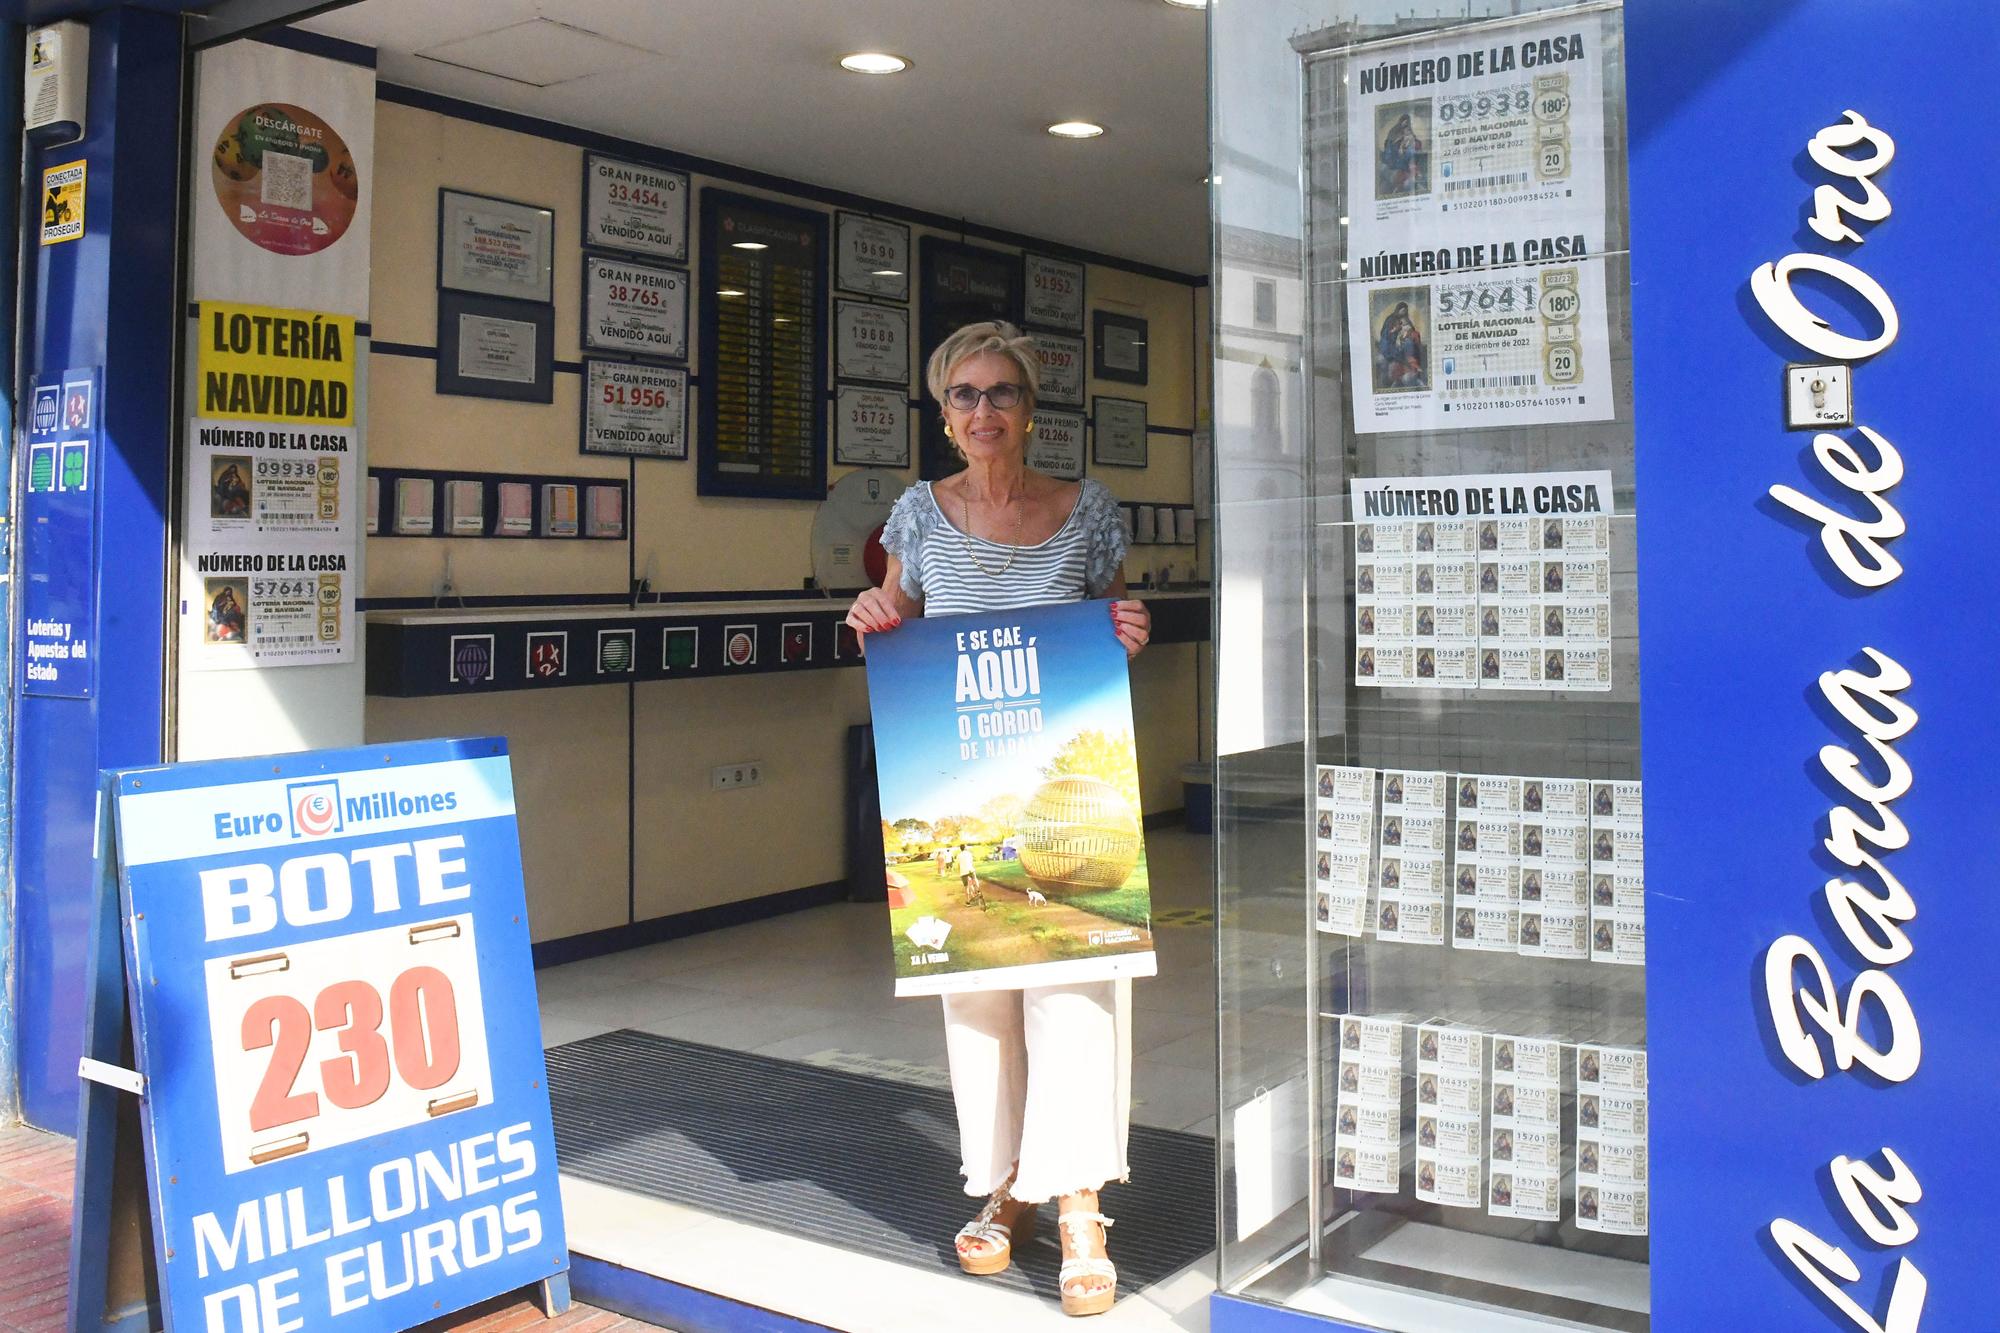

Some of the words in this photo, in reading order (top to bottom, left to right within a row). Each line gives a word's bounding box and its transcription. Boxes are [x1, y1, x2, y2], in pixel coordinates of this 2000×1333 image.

[1360, 56, 1451, 95] NÚMERO
[1457, 51, 1484, 79] DE
[1490, 46, 1516, 74] LA
[1521, 33, 1585, 68] CASA
[1439, 90, 1530, 122] 09938
[256, 115, 323, 139] DESCÁRGATE
[1480, 118, 1528, 132] NACIONAL
[1469, 131, 1512, 144] NAVIDAD
[1545, 154, 1560, 166] 20
[47, 168, 82, 184] CONECTADA
[599, 166, 632, 182] GRAN
[636, 173, 676, 191] PREMIO
[609, 183, 659, 207] 33.454
[45, 222, 80, 238] PROSEGUR
[600, 224, 644, 241] VENDIDO
[648, 233, 672, 245] AQUÍ
[1750, 109, 1899, 359] Oro
[1360, 248, 1451, 283] NÚMERO
[1457, 244, 1485, 273] DE
[1490, 240, 1518, 269] LA
[1522, 234, 1588, 267] CASA
[599, 268, 632, 283] GRAN
[635, 274, 676, 290] PREMIO
[609, 285, 659, 306] 38.765
[1439, 285, 1534, 313] 57641
[1438, 318, 1480, 331] LOTERÍA
[1483, 316, 1535, 327] NACIONAL
[213, 312, 342, 362] LOTERÍA
[600, 326, 644, 341] VENDIDO
[647, 333, 672, 345] AQUÍ
[852, 326, 894, 343] 19688
[1455, 331, 1469, 341] DE
[1471, 328, 1518, 339] NAVIDAD
[1444, 343, 1453, 351] 22
[1455, 342, 1463, 351] de
[1464, 340, 1499, 350] diciembre
[1501, 339, 1511, 347] de
[1512, 338, 1530, 347] 2022
[1555, 357, 1571, 370] 20
[613, 373, 639, 384] GRAN
[641, 376, 677, 388] PREMIO
[205, 371, 348, 419] NAVIDAD
[603, 384, 665, 409] 51.956
[852, 410, 894, 426] 36725
[200, 426, 265, 448] NÚMERO
[269, 432, 286, 449] DE
[289, 433, 307, 450] LA
[310, 434, 348, 452] CASA
[596, 429, 645, 442] VENDIDO
[1039, 428, 1069, 442] 82.266
[257, 462, 316, 475] 09938
[1363, 485, 1459, 517] NÚMERO
[1465, 488, 1494, 515] DE
[1500, 487, 1528, 514] LA
[1533, 484, 1601, 513] CASA
[1768, 425, 1906, 587] de
[198, 552, 264, 572] NÚMERO
[267, 555, 285, 571] DE
[288, 555, 305, 571] LA
[308, 554, 346, 571] CASA
[1566, 563, 1595, 571] 57641
[253, 582, 315, 595] 57641
[27, 618, 63, 636] Loterías
[64, 624, 71, 641] y
[324, 625, 334, 633] 20
[956, 632, 966, 651] E
[969, 630, 989, 650] SE
[992, 626, 1022, 648] CAE
[28, 640, 69, 662] Apuestas
[71, 640, 87, 658] del
[1436, 650, 1465, 658] 09938
[1502, 650, 1529, 658] 57641
[27, 662, 58, 681] Estado
[955, 637, 1041, 703] AQUÍ
[958, 715, 971, 740] O
[977, 707, 1043, 738] GORDO
[960, 741, 979, 760] DE
[1337, 771, 1362, 779] 32159
[1406, 777, 1433, 785] 23034
[1479, 780, 1508, 788] 68532
[1545, 784, 1575, 792] 49173
[214, 811, 283, 839] Euro
[347, 788, 458, 822] Millones
[1335, 813, 1360, 821] 32159
[1404, 819, 1433, 827] 23034
[1479, 823, 1508, 832] 68532
[1545, 828, 1575, 837] 49173
[1332, 854, 1359, 863] 32159
[1403, 861, 1431, 869] 23034
[1765, 646, 1922, 1082] Barca
[200, 834, 472, 942] BOTE
[1401, 904, 1430, 912] 23034
[1477, 911, 1508, 919] 68532
[1543, 917, 1574, 926] 49173
[1440, 1034, 1468, 1044] 04435
[241, 965, 461, 1132] 230
[1518, 1044, 1545, 1053] 15701
[1518, 1088, 1545, 1097] 15701
[1439, 1122, 1467, 1131] 04435
[1517, 1133, 1545, 1142] 15701
[1602, 1145, 1632, 1156] 17870
[193, 1122, 537, 1278] MILLONES
[1601, 1191, 1632, 1201] 17870
[1770, 1146, 1927, 1333] La
[203, 1268, 304, 1333] DE
[325, 1190, 543, 1316] EUROS
